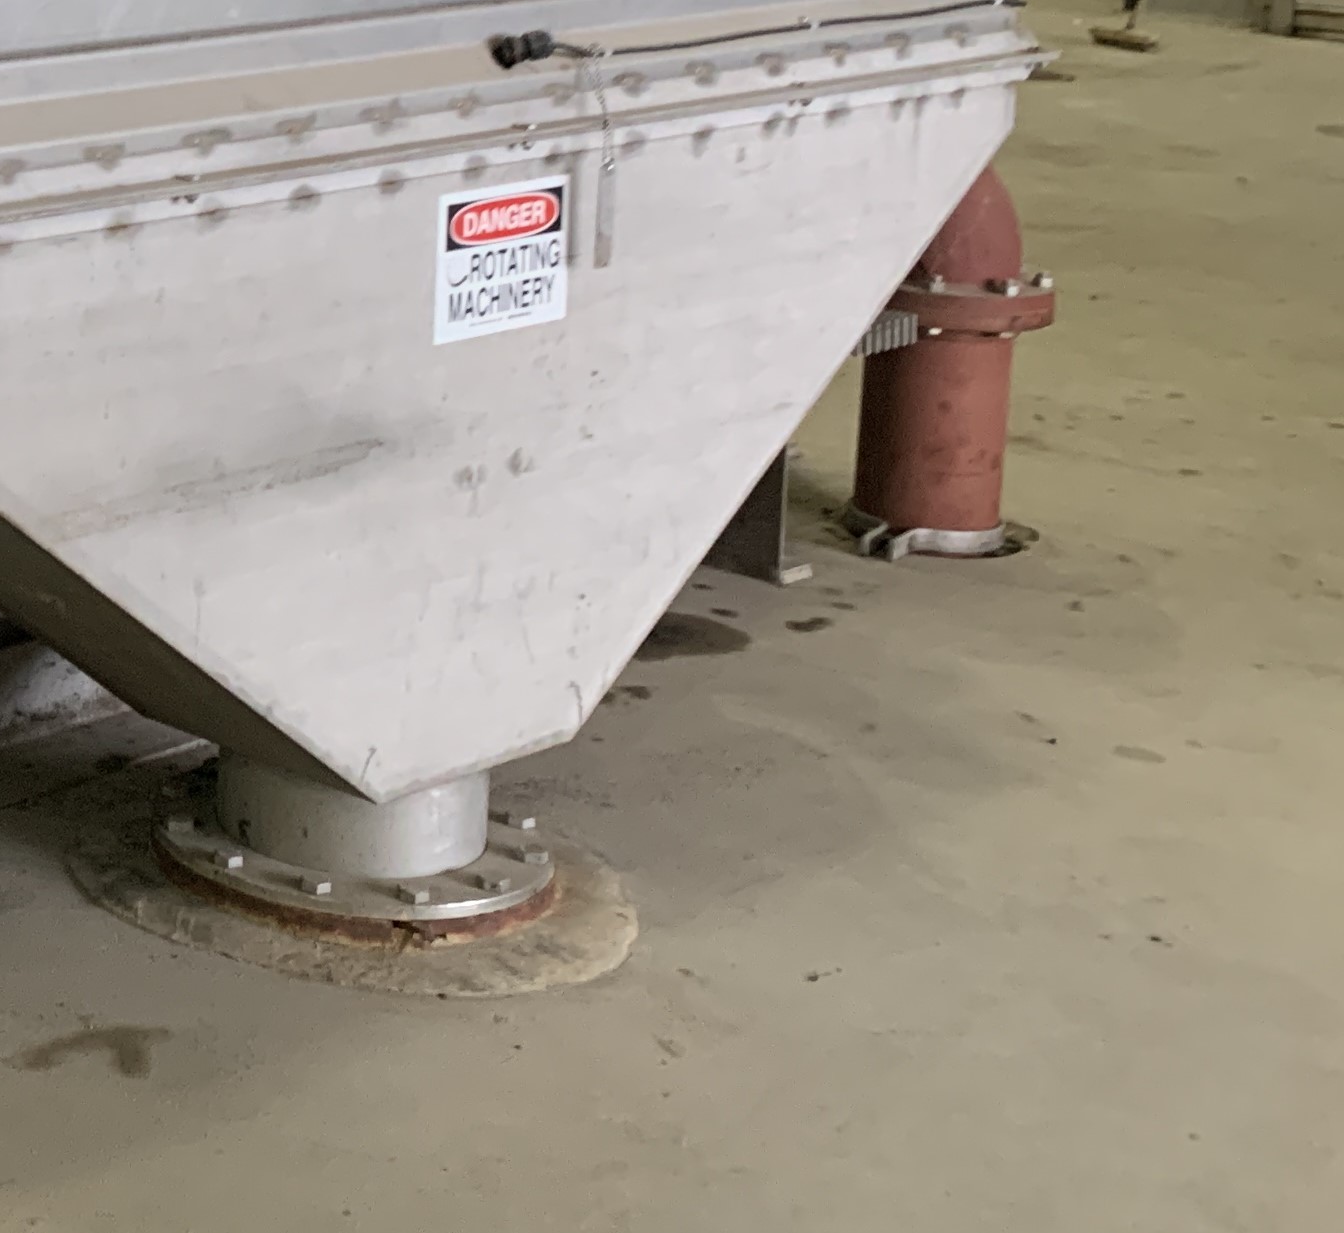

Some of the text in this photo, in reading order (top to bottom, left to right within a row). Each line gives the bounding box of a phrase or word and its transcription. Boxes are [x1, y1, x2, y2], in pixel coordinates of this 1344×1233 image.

[462, 200, 547, 238] DANGER
[471, 239, 560, 282] ROTATING
[447, 274, 556, 323] MACHINERY
